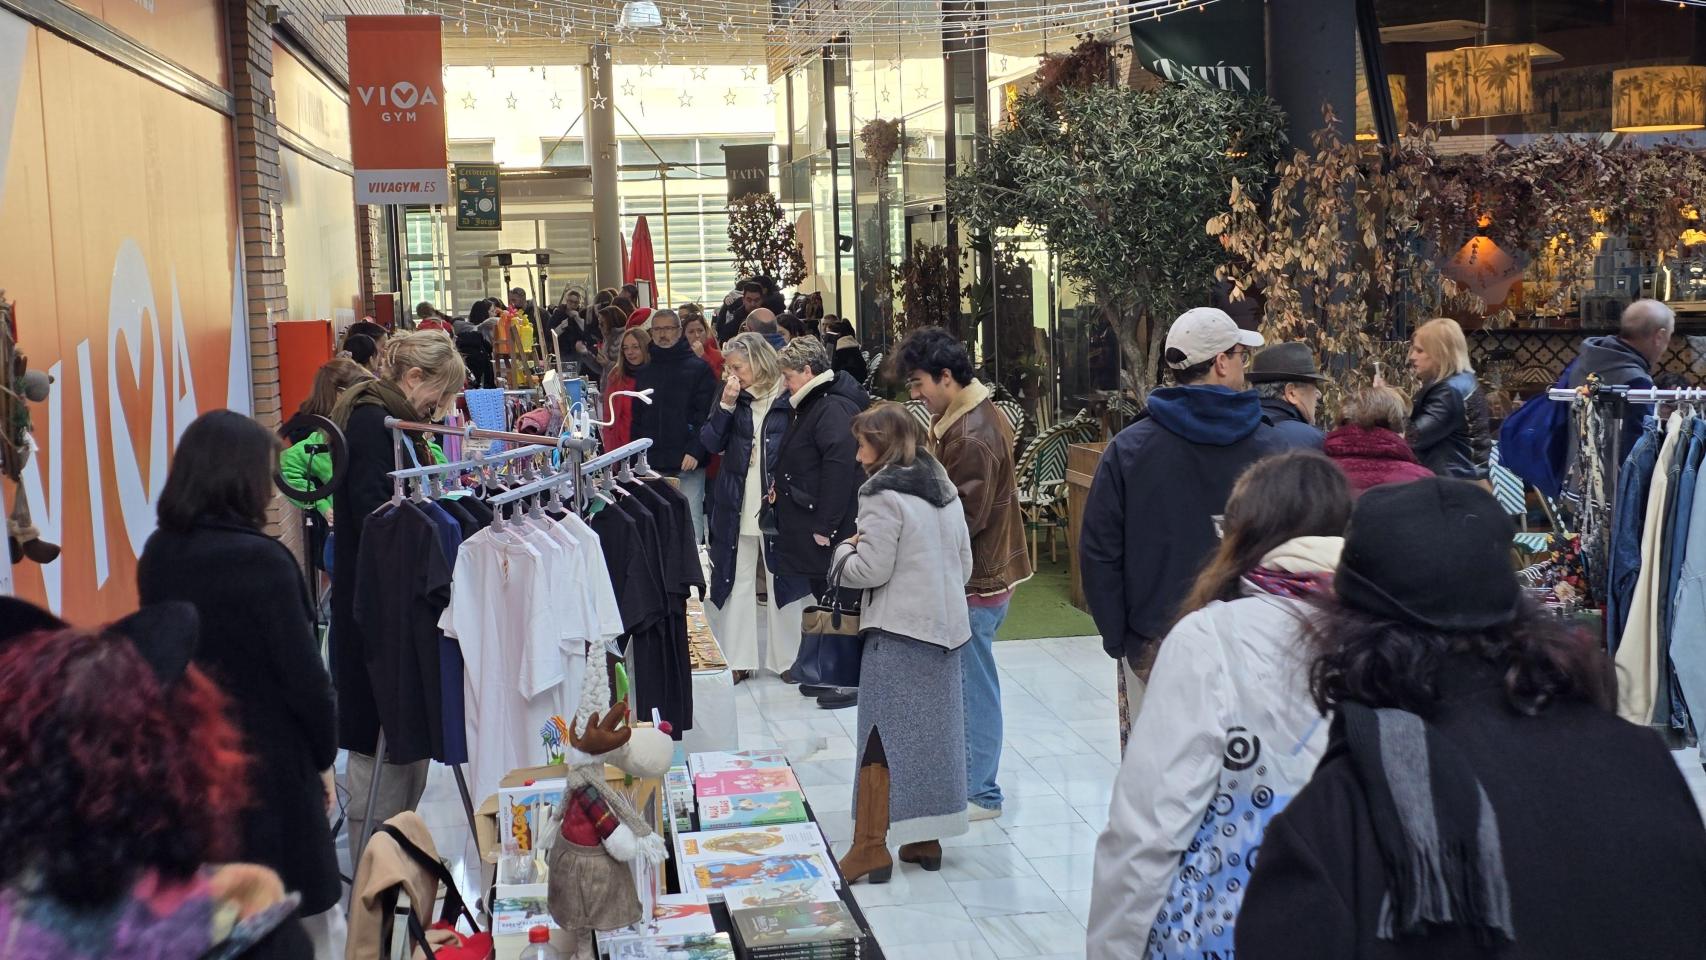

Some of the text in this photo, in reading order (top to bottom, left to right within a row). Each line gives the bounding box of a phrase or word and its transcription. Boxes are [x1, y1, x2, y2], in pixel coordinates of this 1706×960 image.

[356, 81, 439, 109] VIVA
[381, 112, 417, 122] GYM
[368, 181, 437, 193] VIVAGYM.ES
